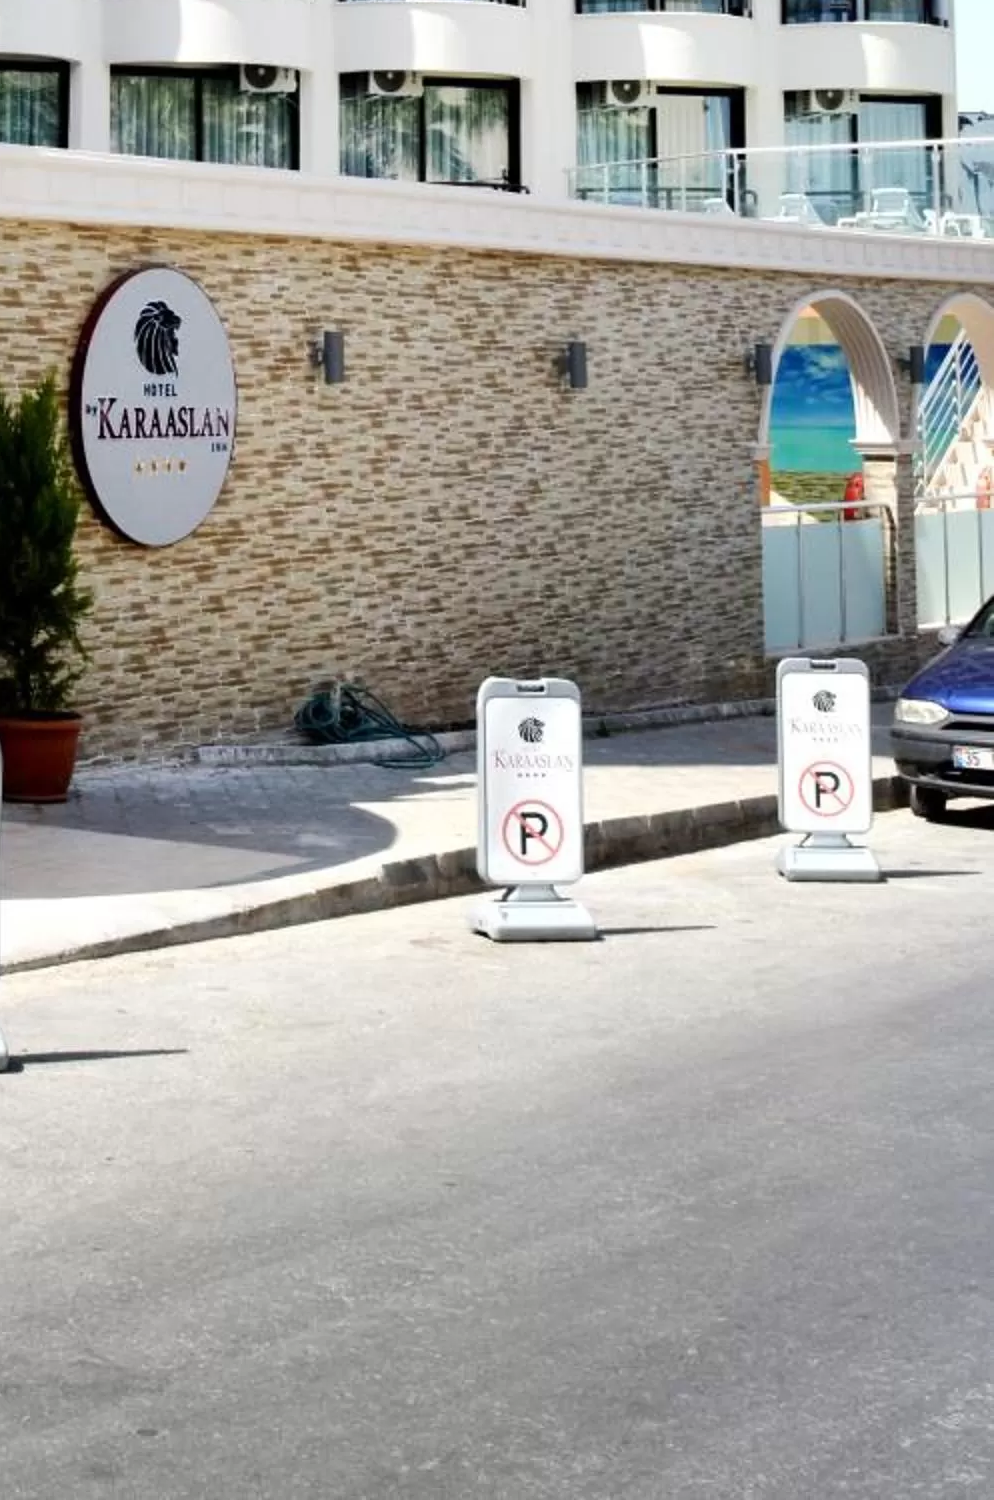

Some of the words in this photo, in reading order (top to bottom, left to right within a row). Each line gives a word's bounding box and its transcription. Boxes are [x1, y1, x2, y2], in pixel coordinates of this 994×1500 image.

[143, 383, 177, 397] HOTEL
[98, 397, 229, 439] KARAASLAN
[814, 772, 840, 809] P
[520, 812, 548, 855] P
